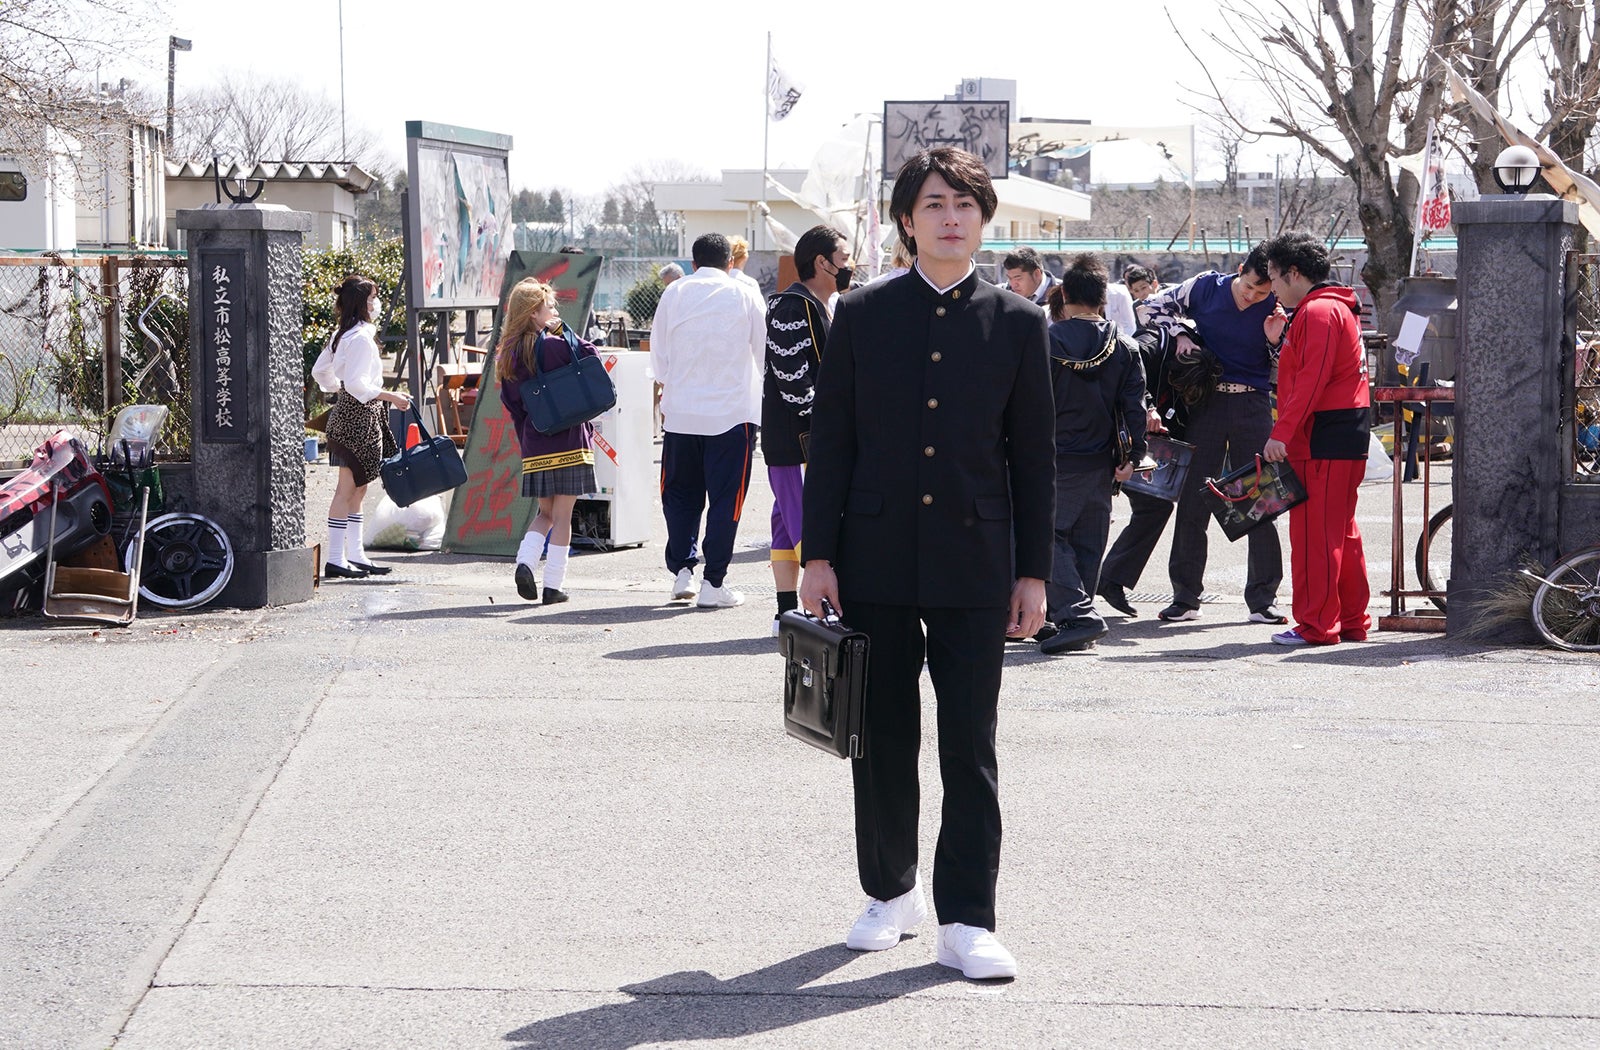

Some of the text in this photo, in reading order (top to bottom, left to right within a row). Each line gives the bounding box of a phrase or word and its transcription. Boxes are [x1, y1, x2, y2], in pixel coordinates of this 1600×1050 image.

[212, 265, 233, 428] 私立市松高等学校
